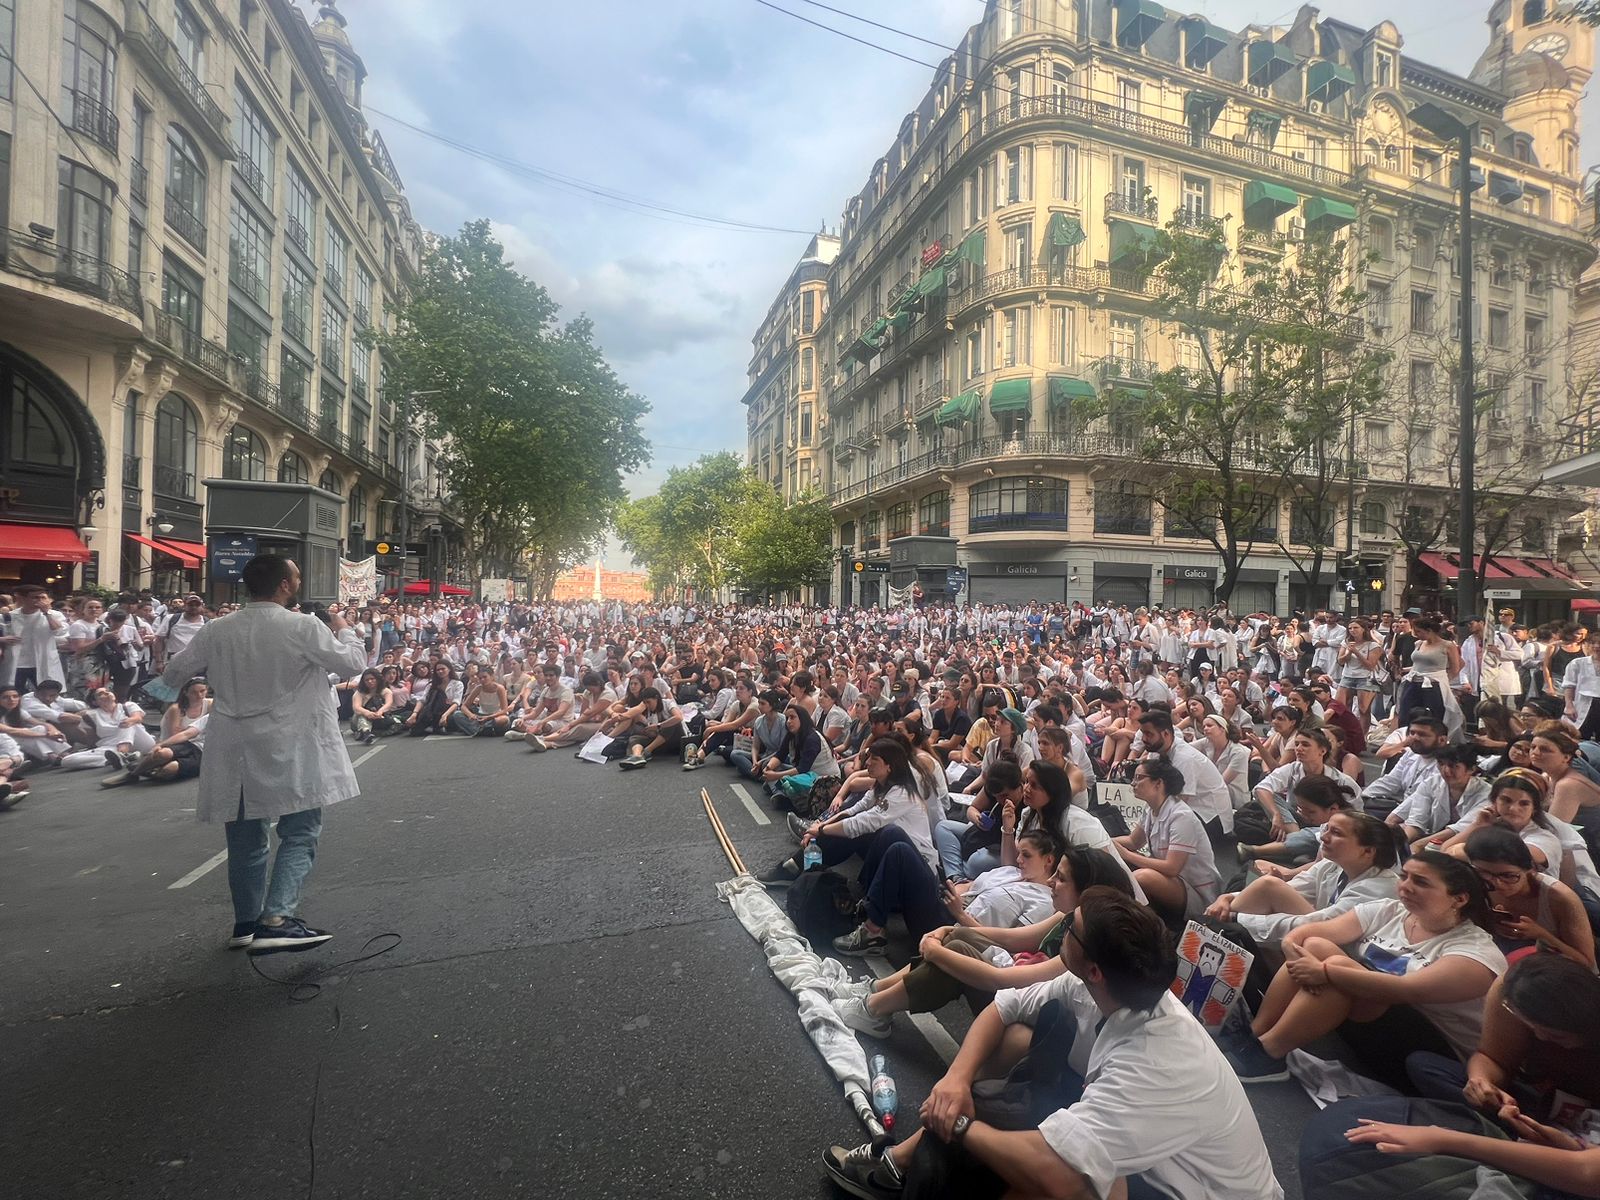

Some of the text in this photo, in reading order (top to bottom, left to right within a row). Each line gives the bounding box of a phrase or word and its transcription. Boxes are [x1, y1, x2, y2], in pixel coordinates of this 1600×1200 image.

[1007, 564, 1038, 574] Galicia
[1184, 568, 1207, 578] Galicia
[1105, 787, 1122, 801] LA
[1188, 921, 1248, 959] HTAL ELIZALDE
